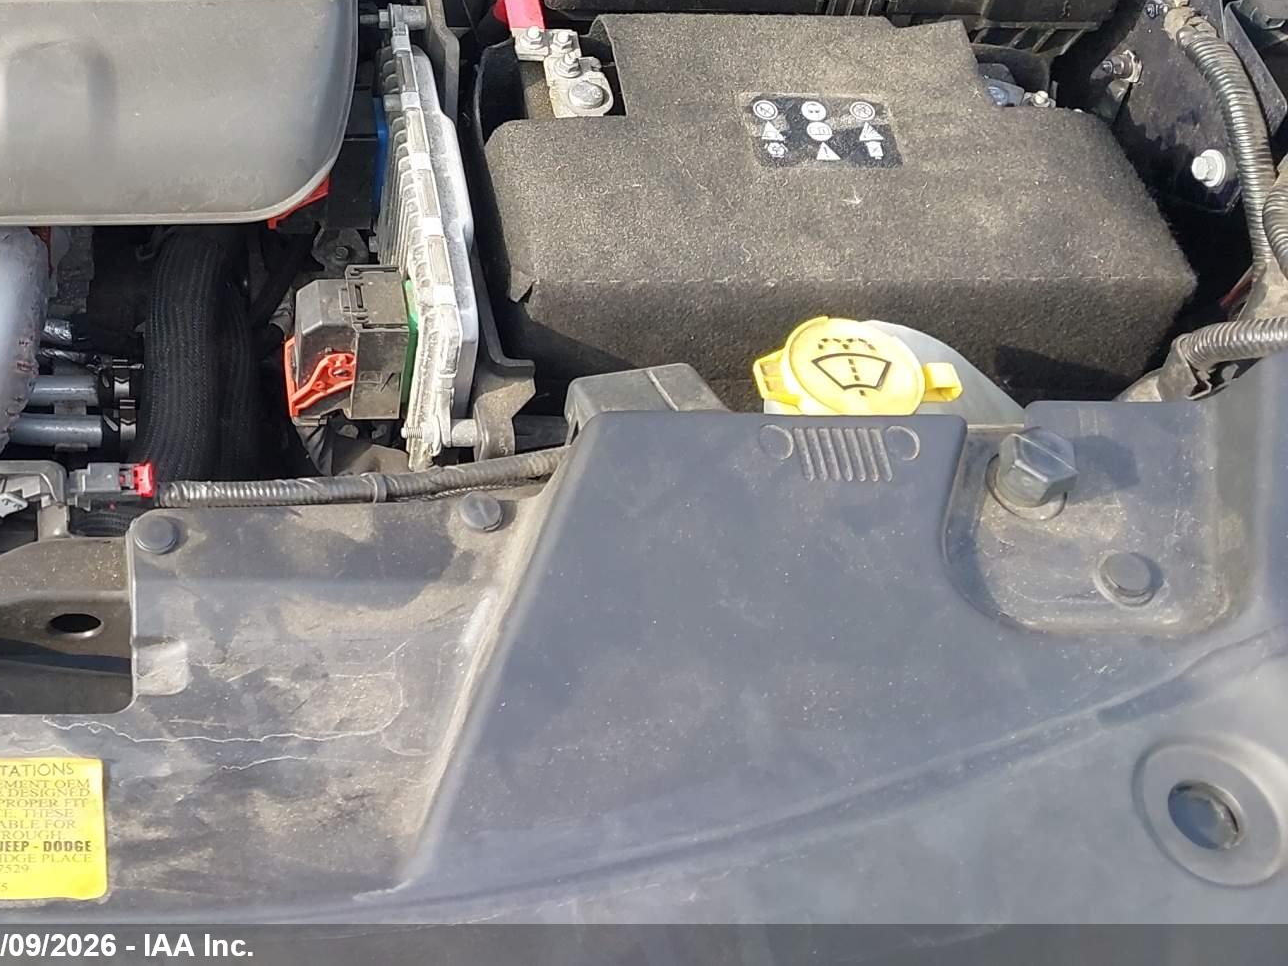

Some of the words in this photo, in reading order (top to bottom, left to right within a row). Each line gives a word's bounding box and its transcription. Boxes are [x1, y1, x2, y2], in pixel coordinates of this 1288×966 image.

[54, 778, 90, 789] OEM
[7, 787, 91, 798] DESIGNED
[64, 797, 90, 808] FIT
[22, 808, 75, 819] THESE
[44, 819, 77, 830] FOR
[42, 840, 92, 852] DODGE
[41, 853, 94, 864] PLACE
